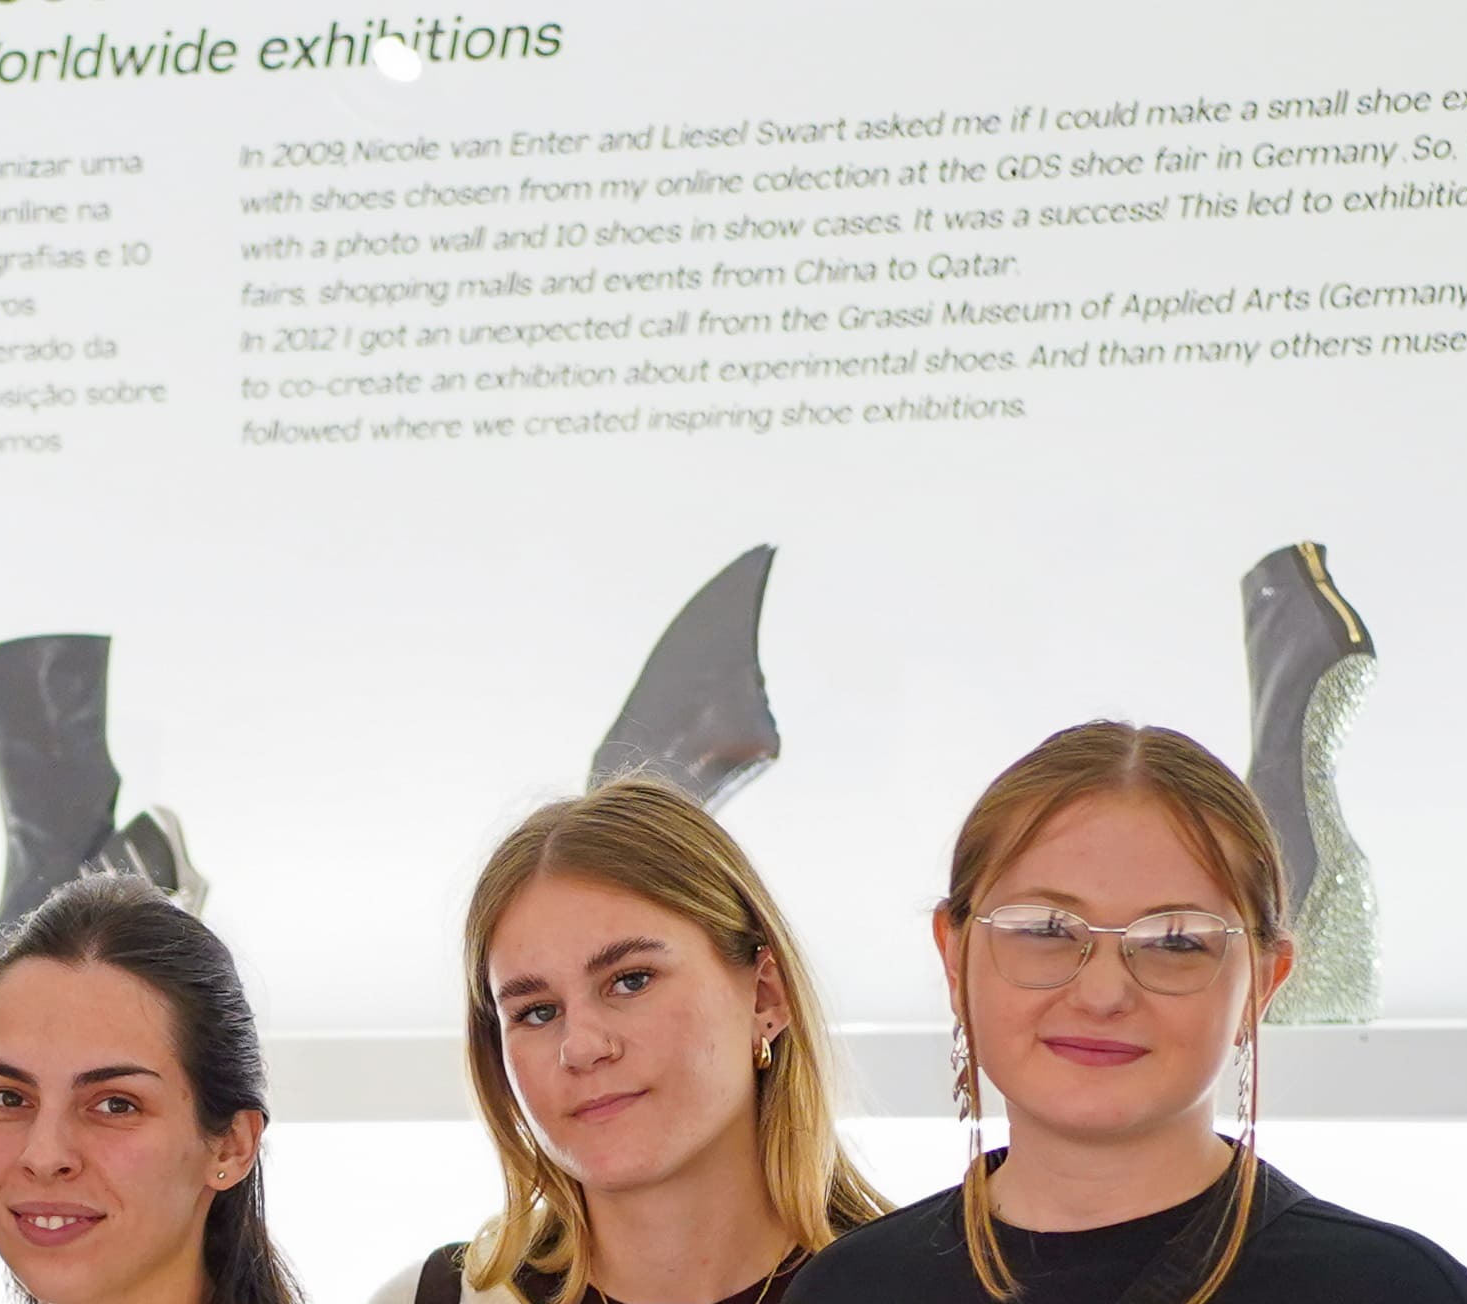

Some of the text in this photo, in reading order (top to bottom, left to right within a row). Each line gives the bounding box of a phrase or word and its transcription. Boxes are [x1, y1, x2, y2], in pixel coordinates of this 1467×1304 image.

[239, 146, 265, 167] In
[352, 136, 441, 163] Nicole
[450, 138, 502, 159] van
[509, 130, 591, 157] Enter
[597, 125, 655, 153] and
[661, 119, 749, 150] Liesel
[756, 116, 847, 147] Swart
[854, 109, 946, 141] asked
[951, 114, 1002, 136] me
[1010, 105, 1031, 133] if
[1054, 100, 1140, 131] could
[1145, 95, 1233, 126] make
[1239, 100, 1260, 122] a
[1266, 88, 1350, 121] small
[1355, 86, 1433, 116] shoe
[240, 189, 303, 214] with
[310, 187, 397, 213] shoes
[403, 183, 511, 209] chosen
[519, 176, 593, 203] from
[599, 178, 648, 202] my
[655, 169, 744, 198] online
[752, 164, 891, 193] colection
[897, 160, 929, 187] at
[938, 156, 988, 184] the
[995, 152, 1063, 182] GDS
[1069, 150, 1145, 178] shoe
[1154, 144, 1209, 174] fair
[1215, 144, 1244, 171] in
[240, 235, 304, 260] with
[310, 238, 328, 259] a
[334, 231, 421, 261] photo
[429, 225, 487, 253] wall
[492, 223, 549, 251] and
[555, 222, 589, 249] 10
[594, 219, 683, 247] shoes
[690, 222, 717, 241] in
[723, 213, 806, 242] show
[913, 207, 934, 233] It
[943, 208, 1005, 231] was
[1011, 207, 1031, 229] a
[1180, 191, 1239, 220] This
[1245, 187, 1294, 218] led
[1301, 188, 1334, 215] to
[318, 279, 451, 308] shopping
[456, 270, 534, 299] malls
[540, 266, 598, 296] and
[602, 265, 703, 294] events
[711, 261, 787, 288] from
[793, 257, 879, 286] China
[887, 255, 919, 282] to
[240, 331, 265, 353] In
[359, 324, 408, 357] got
[415, 327, 452, 347] an
[458, 313, 633, 348] unexpected
[638, 310, 690, 339] call
[697, 309, 772, 336] from
[780, 305, 829, 333] the
[837, 301, 934, 331] Grassi
[941, 300, 1073, 325] Museum
[1080, 291, 1114, 321] of
[1120, 286, 1237, 324] Applied
[1242, 285, 1311, 313] Arts
[241, 376, 270, 399] to
[278, 370, 423, 399] co-create
[430, 372, 467, 393] an
[474, 363, 617, 391] exhibition
[623, 359, 711, 386] about
[718, 347, 919, 385] experimental
[1027, 340, 1091, 369] And
[1173, 340, 1262, 366] many
[1268, 331, 1374, 360] others
[241, 416, 363, 446] followed
[369, 415, 464, 441] where
[472, 416, 516, 437] we
[523, 407, 641, 436] created
[647, 405, 775, 436] inspiring
[780, 400, 854, 428] shoe
